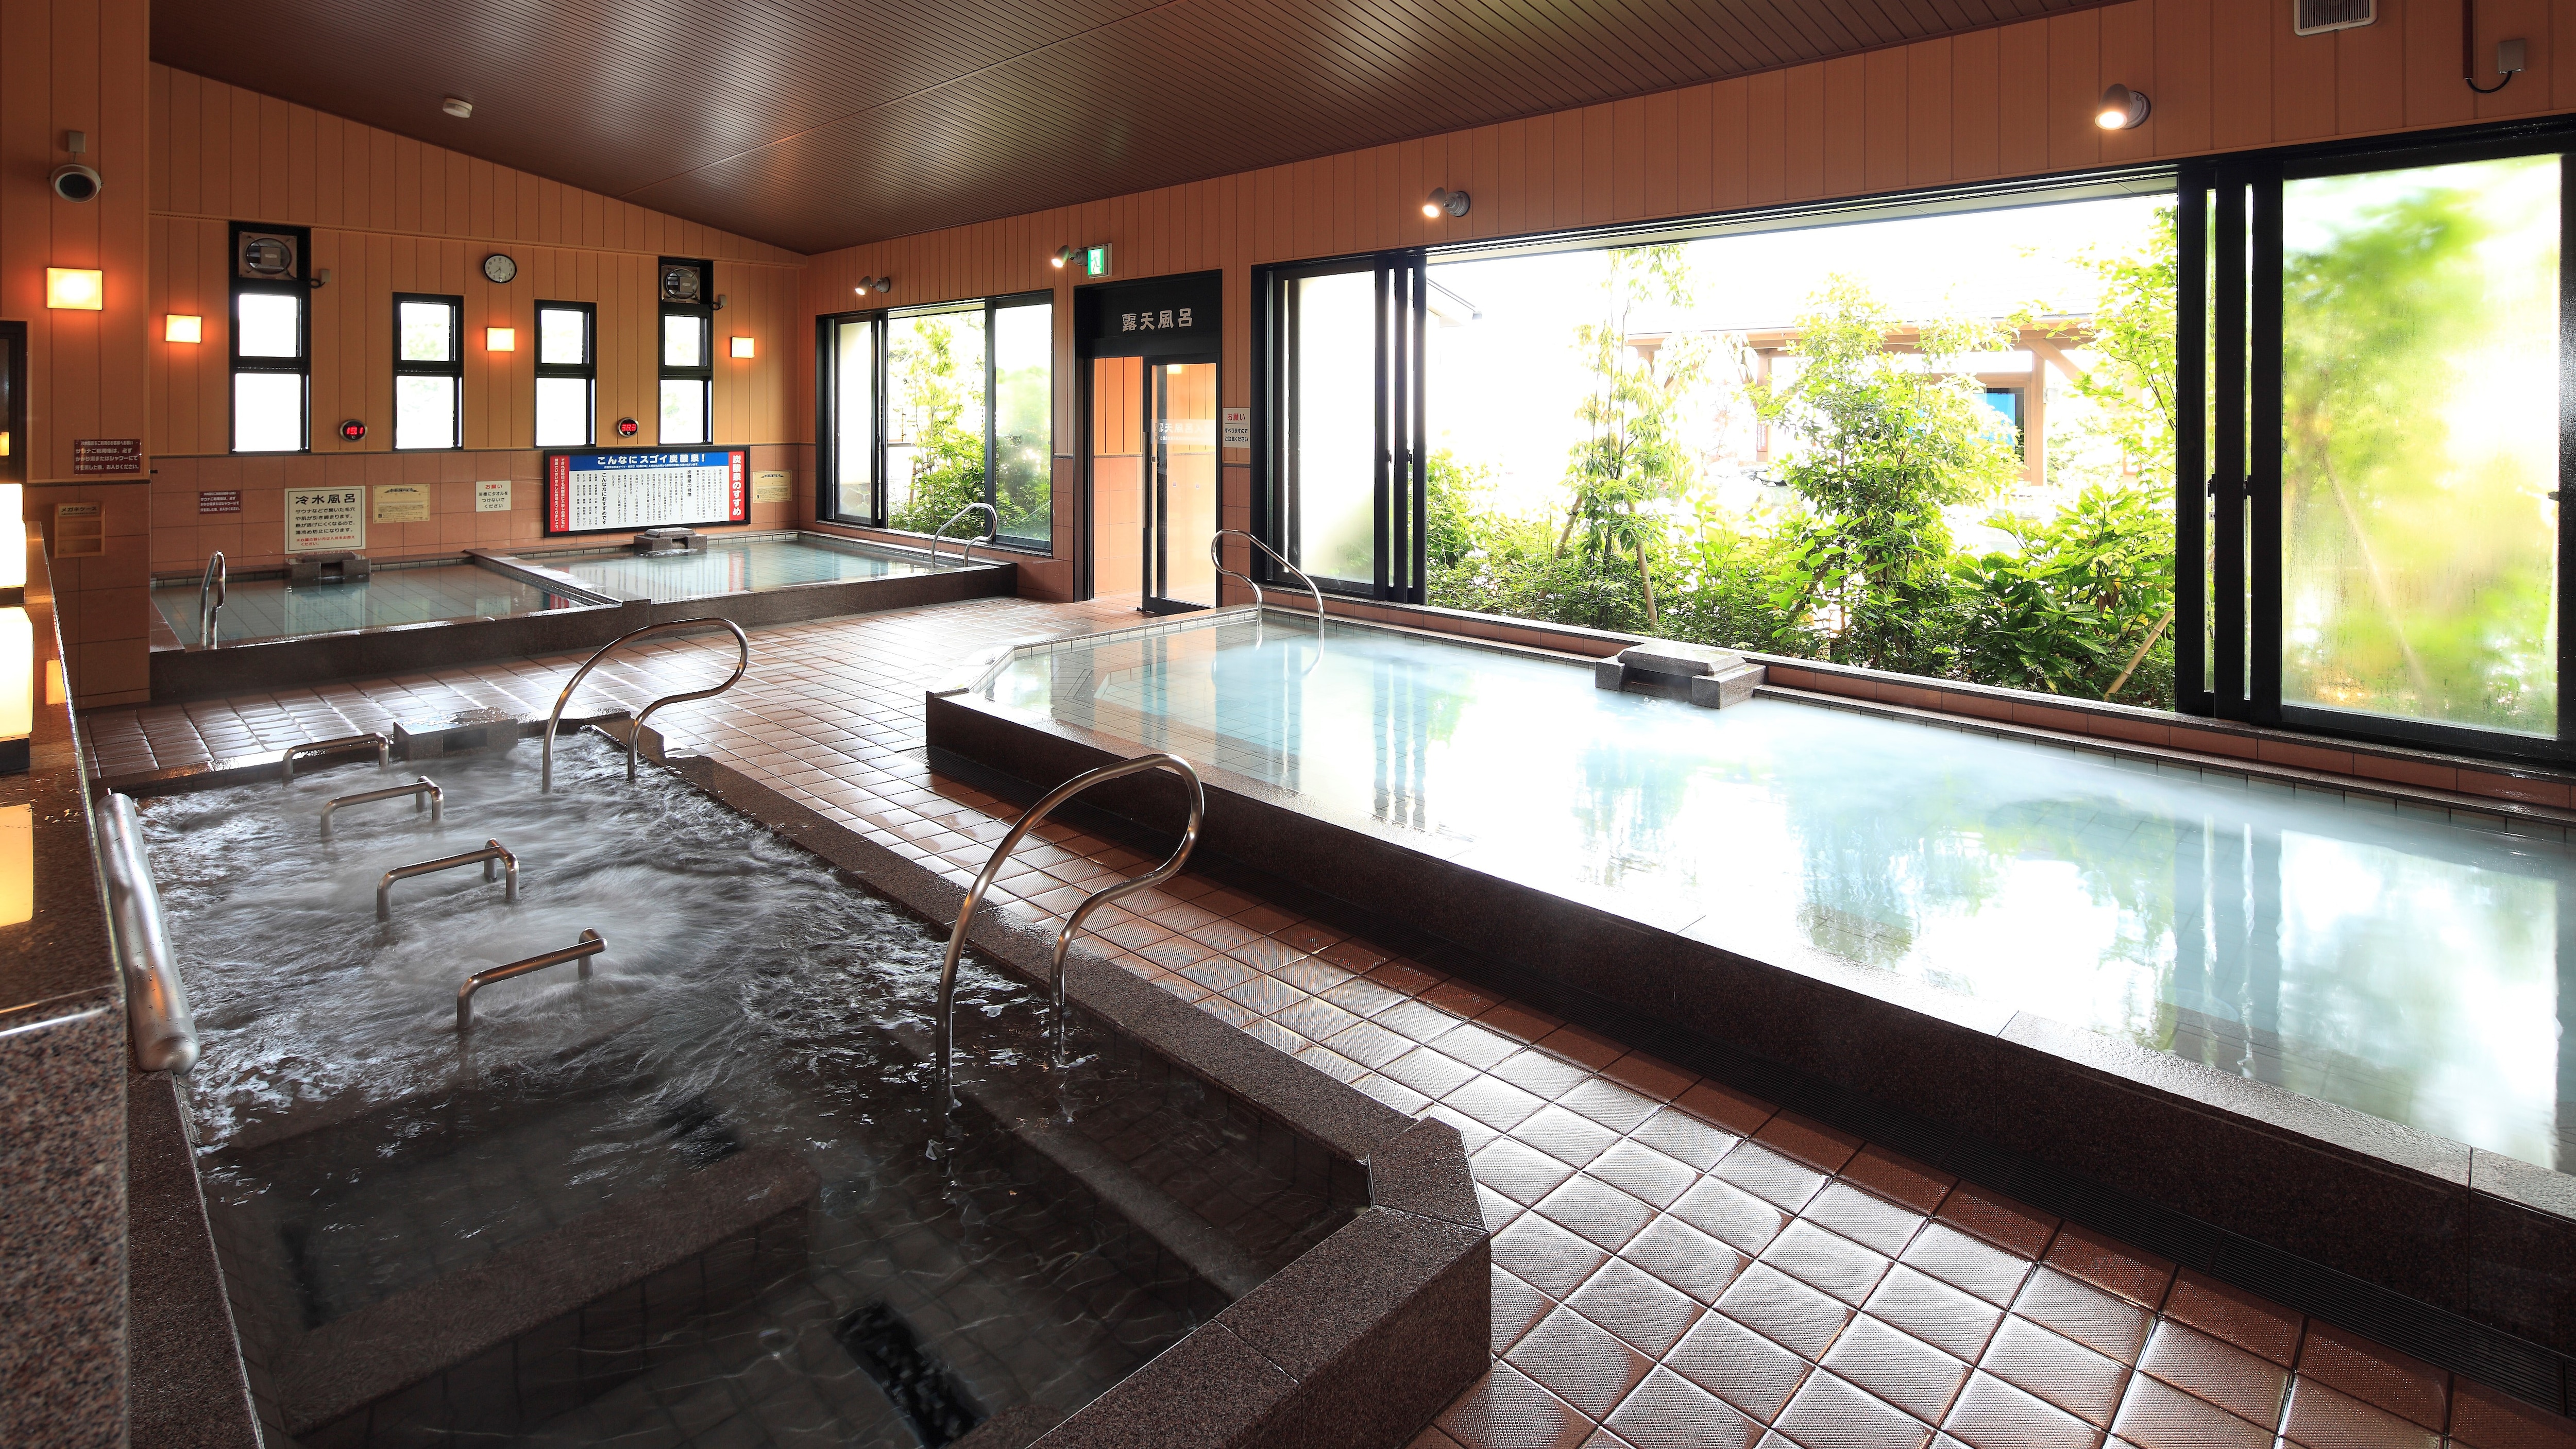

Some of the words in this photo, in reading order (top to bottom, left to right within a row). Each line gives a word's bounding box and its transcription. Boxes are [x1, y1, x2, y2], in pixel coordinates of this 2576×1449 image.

[1122, 308, 1192, 332] 露天風呂
[732, 455, 741, 516] 炭酸泉のすすめ
[296, 493, 355, 505] 冷水風呂
